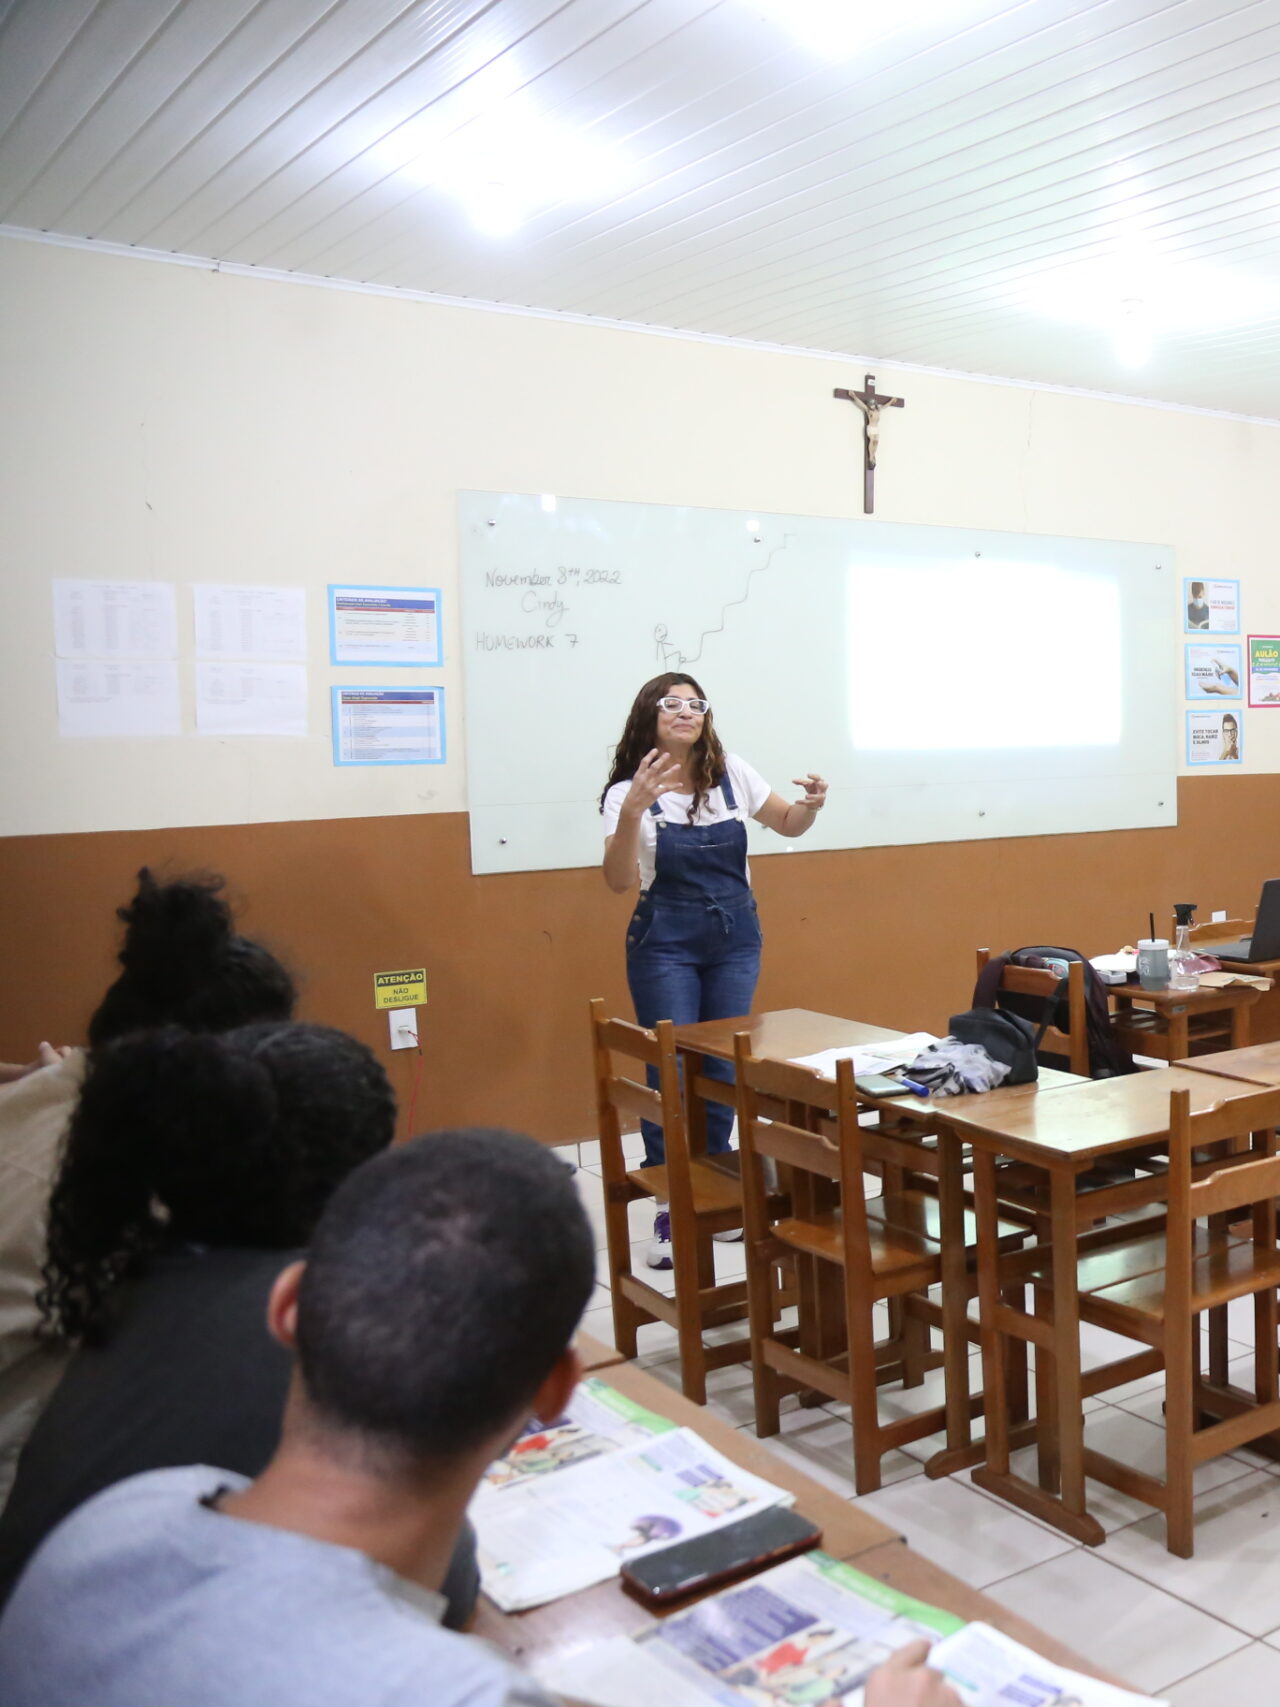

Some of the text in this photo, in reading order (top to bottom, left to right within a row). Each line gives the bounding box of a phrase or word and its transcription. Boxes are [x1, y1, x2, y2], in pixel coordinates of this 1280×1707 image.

[486, 567, 552, 587] November
[583, 567, 623, 584] 2022
[521, 590, 570, 628] Cindy
[476, 632, 580, 652] HOMEWORK 7
[378, 973, 423, 984] ATENÇÃO
[384, 994, 418, 1003] DESLIGUE
